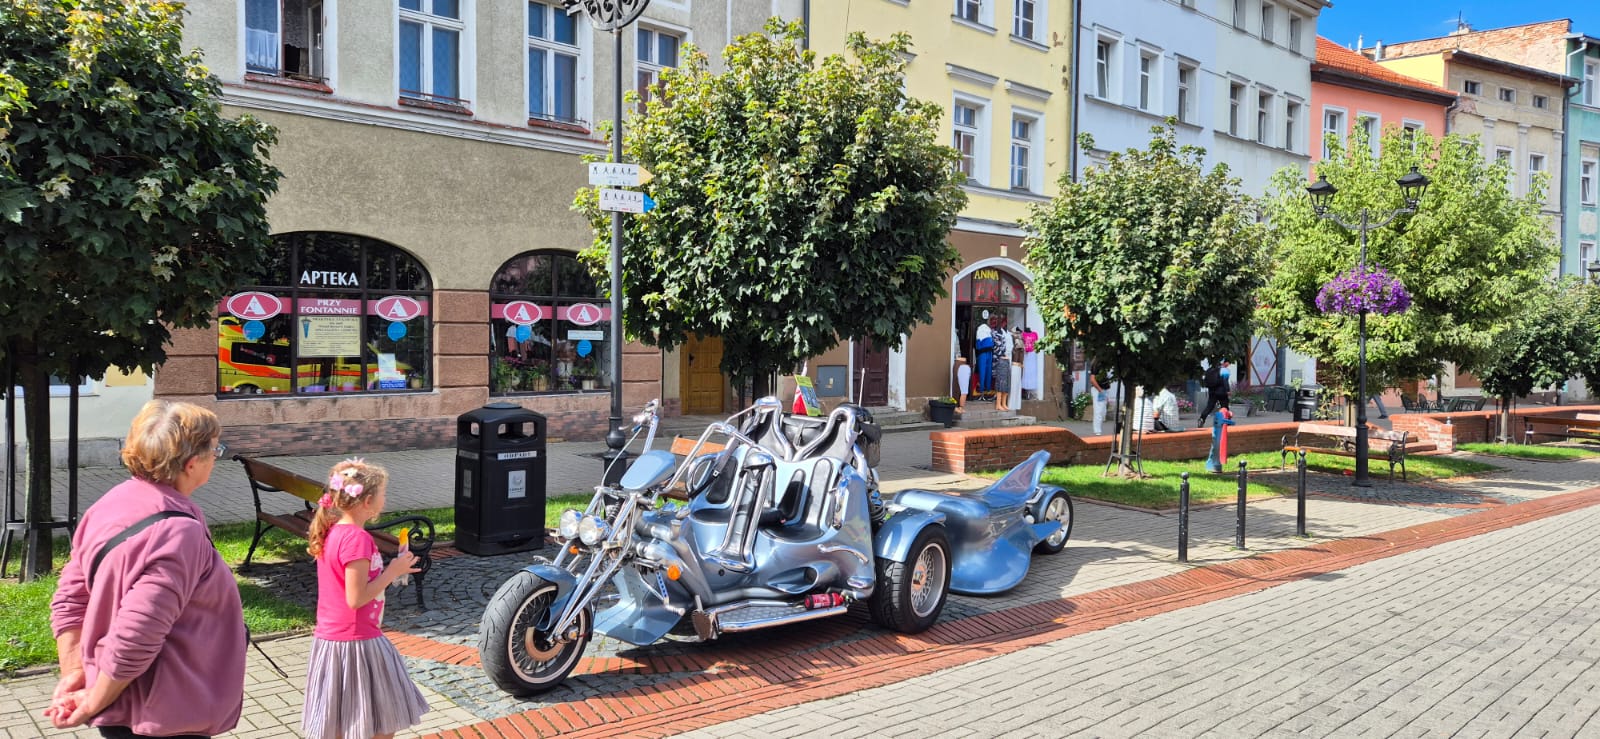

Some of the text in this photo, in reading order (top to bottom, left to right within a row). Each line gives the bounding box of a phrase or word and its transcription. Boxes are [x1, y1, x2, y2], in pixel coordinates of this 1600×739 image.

[300, 270, 359, 286] APTEKA
[974, 270, 998, 280] ANNA
[243, 295, 266, 315] A
[300, 307, 358, 315] FONTANNIE
[317, 299, 341, 307] PRZY
[387, 299, 408, 317] A
[514, 304, 531, 321] A
[576, 306, 593, 322] A
